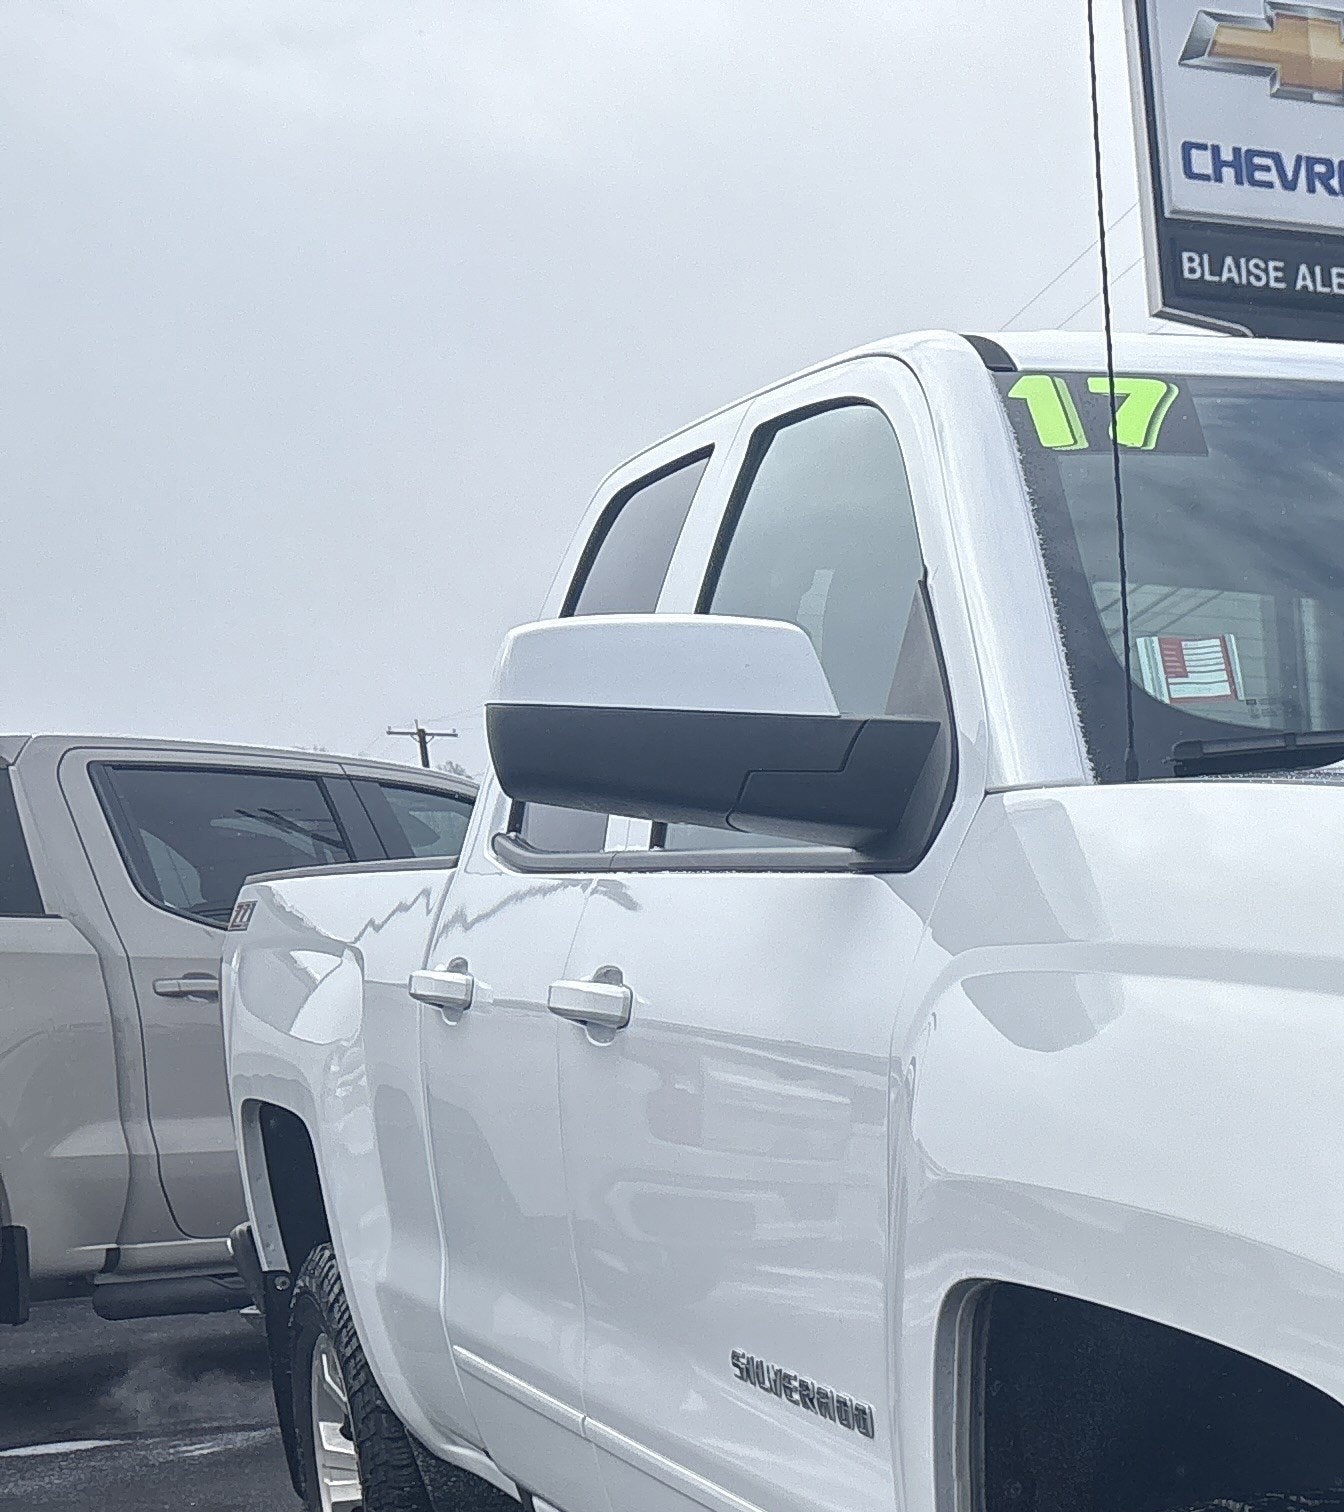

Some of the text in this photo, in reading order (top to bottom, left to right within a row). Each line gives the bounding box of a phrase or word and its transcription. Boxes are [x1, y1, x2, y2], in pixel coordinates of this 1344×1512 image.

[1181, 251, 1287, 290] BLAISE
[1007, 374, 1180, 450] 17
[730, 1349, 875, 1439] SILVERADO
